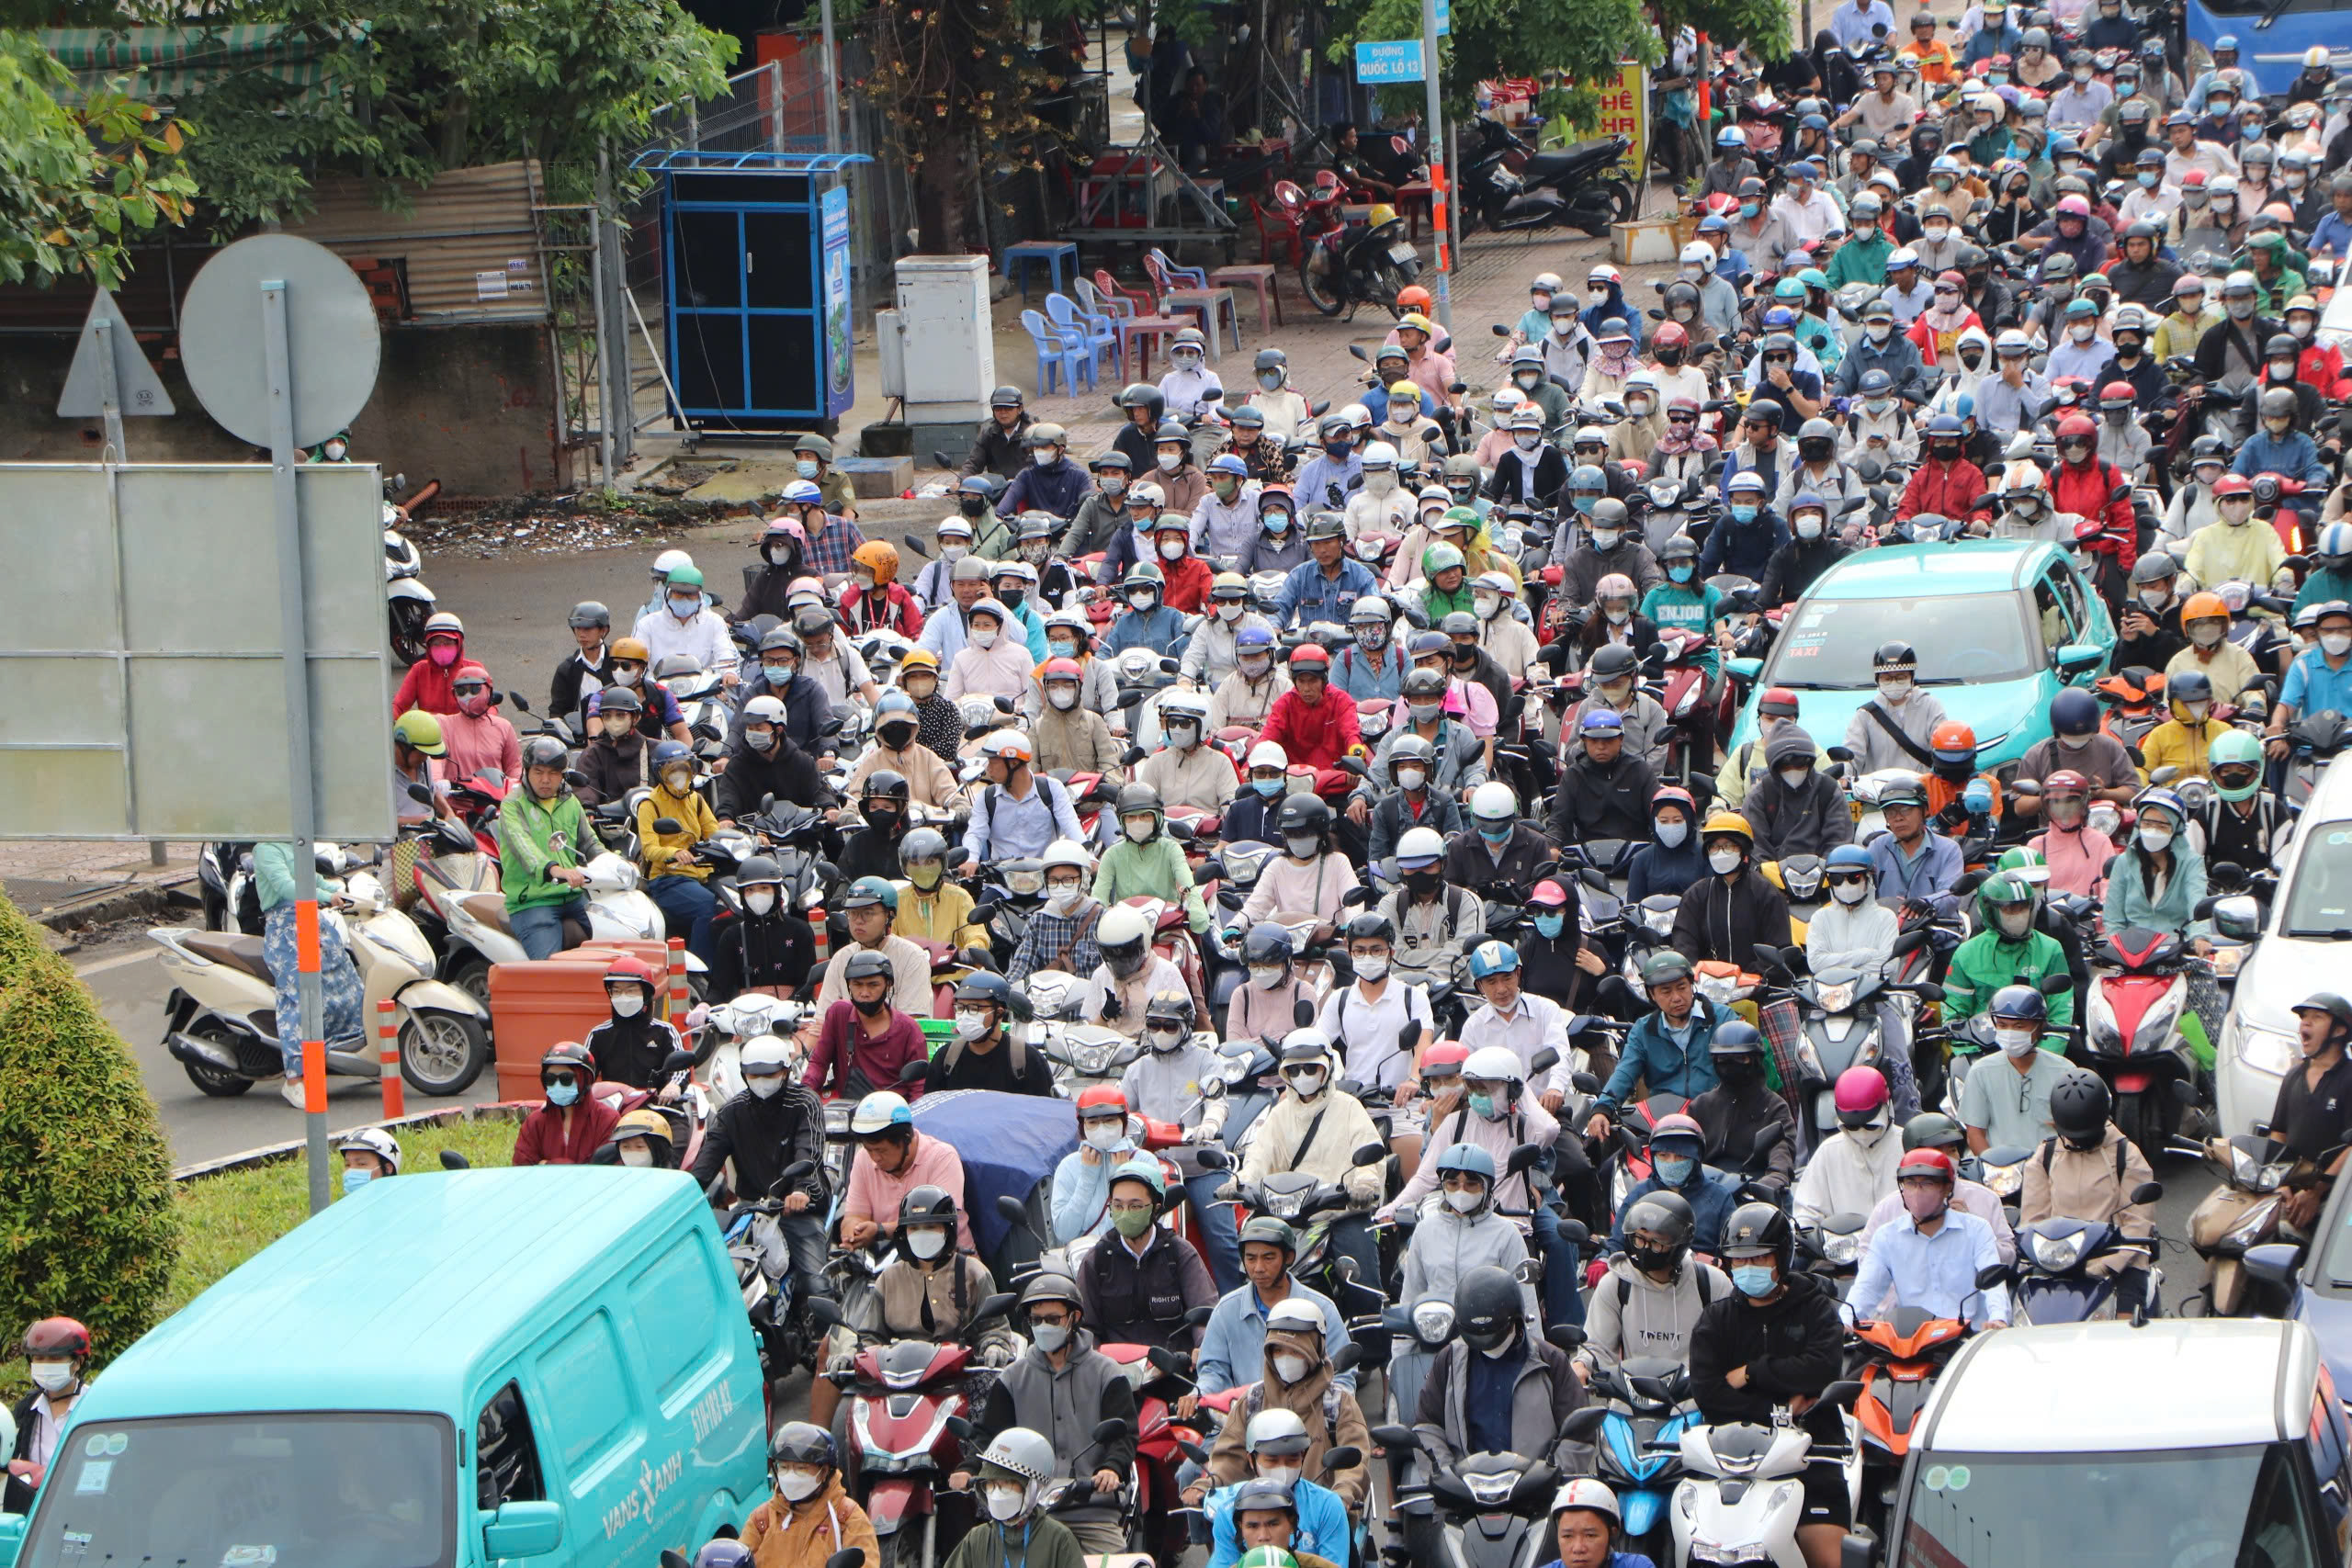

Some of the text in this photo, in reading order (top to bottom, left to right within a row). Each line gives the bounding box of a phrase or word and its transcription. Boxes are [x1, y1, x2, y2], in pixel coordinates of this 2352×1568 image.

[1373, 46, 1404, 57] ĐƯỜNG
[1360, 58, 1419, 77] QUỐC LỘ 13
[1458, 513, 1476, 521] Grab
[1789, 646, 1820, 659] TAXI
[1170, 1294, 1180, 1303] ON
[602, 1488, 640, 1540] VANS
